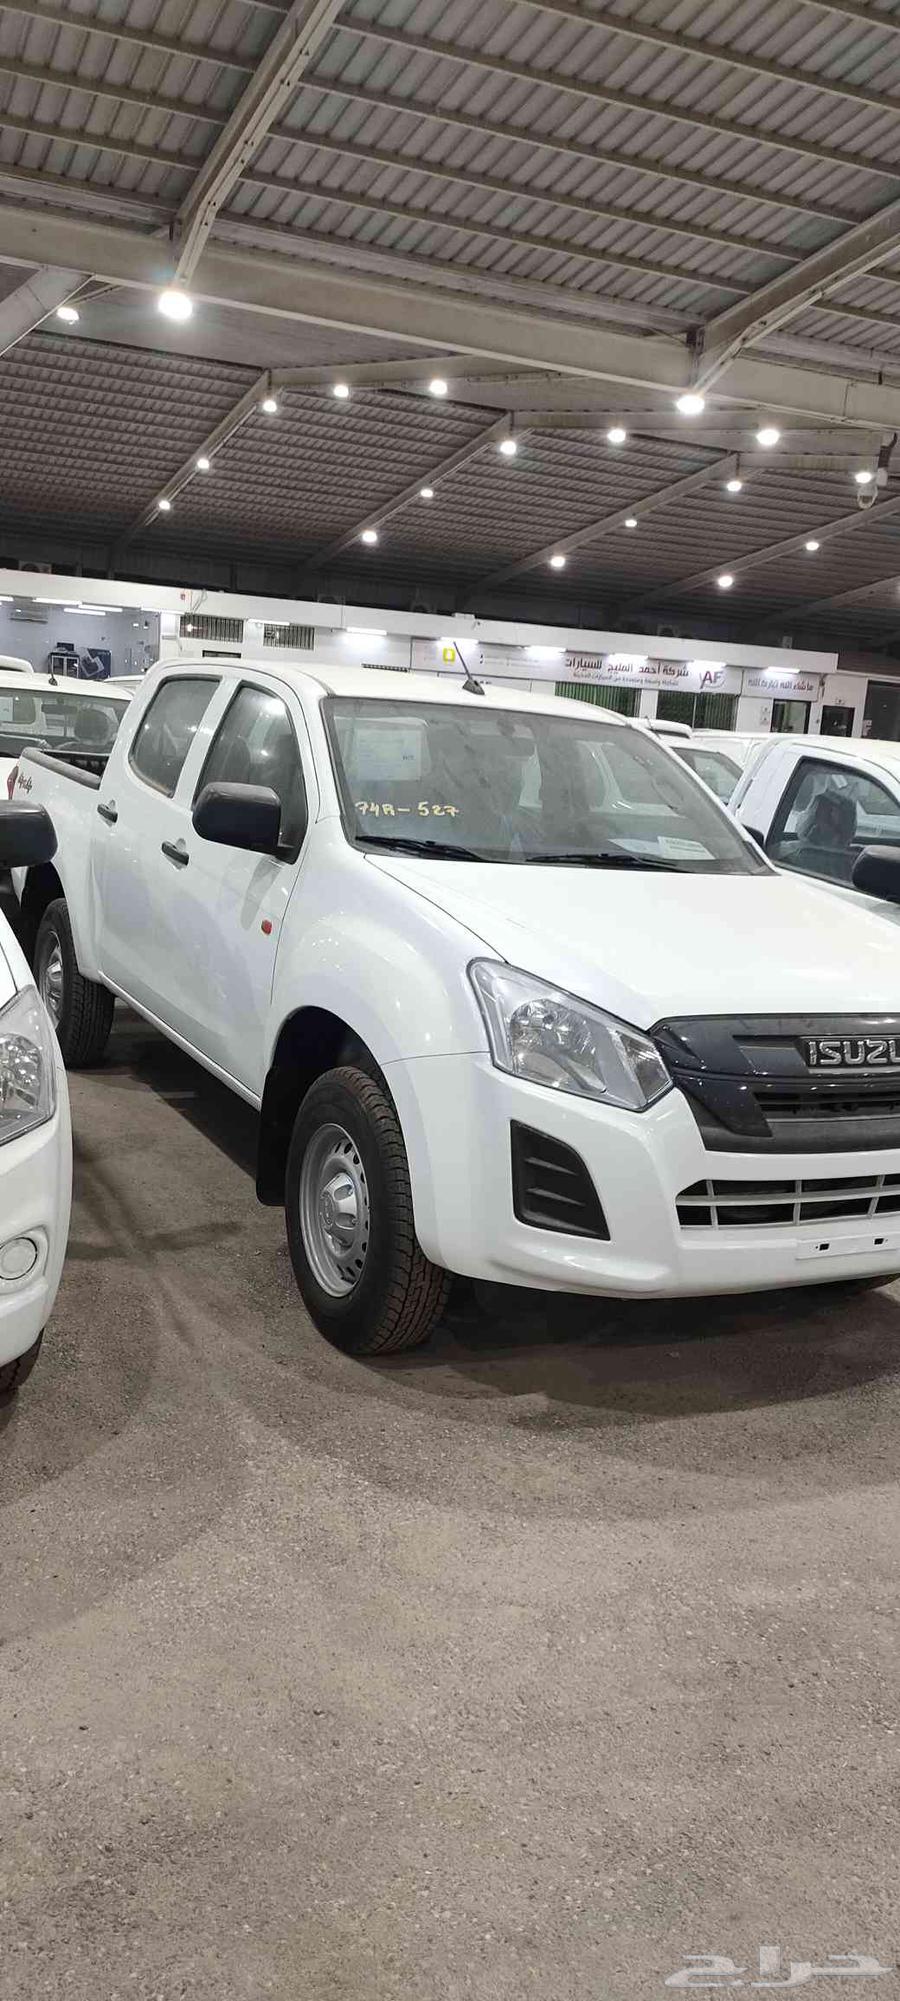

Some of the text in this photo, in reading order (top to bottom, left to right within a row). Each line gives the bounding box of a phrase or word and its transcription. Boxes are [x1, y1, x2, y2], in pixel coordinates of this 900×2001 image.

[565, 657, 602, 672] للسيارات
[638, 661, 661, 674] أحمد
[662, 664, 689, 678] شركة
